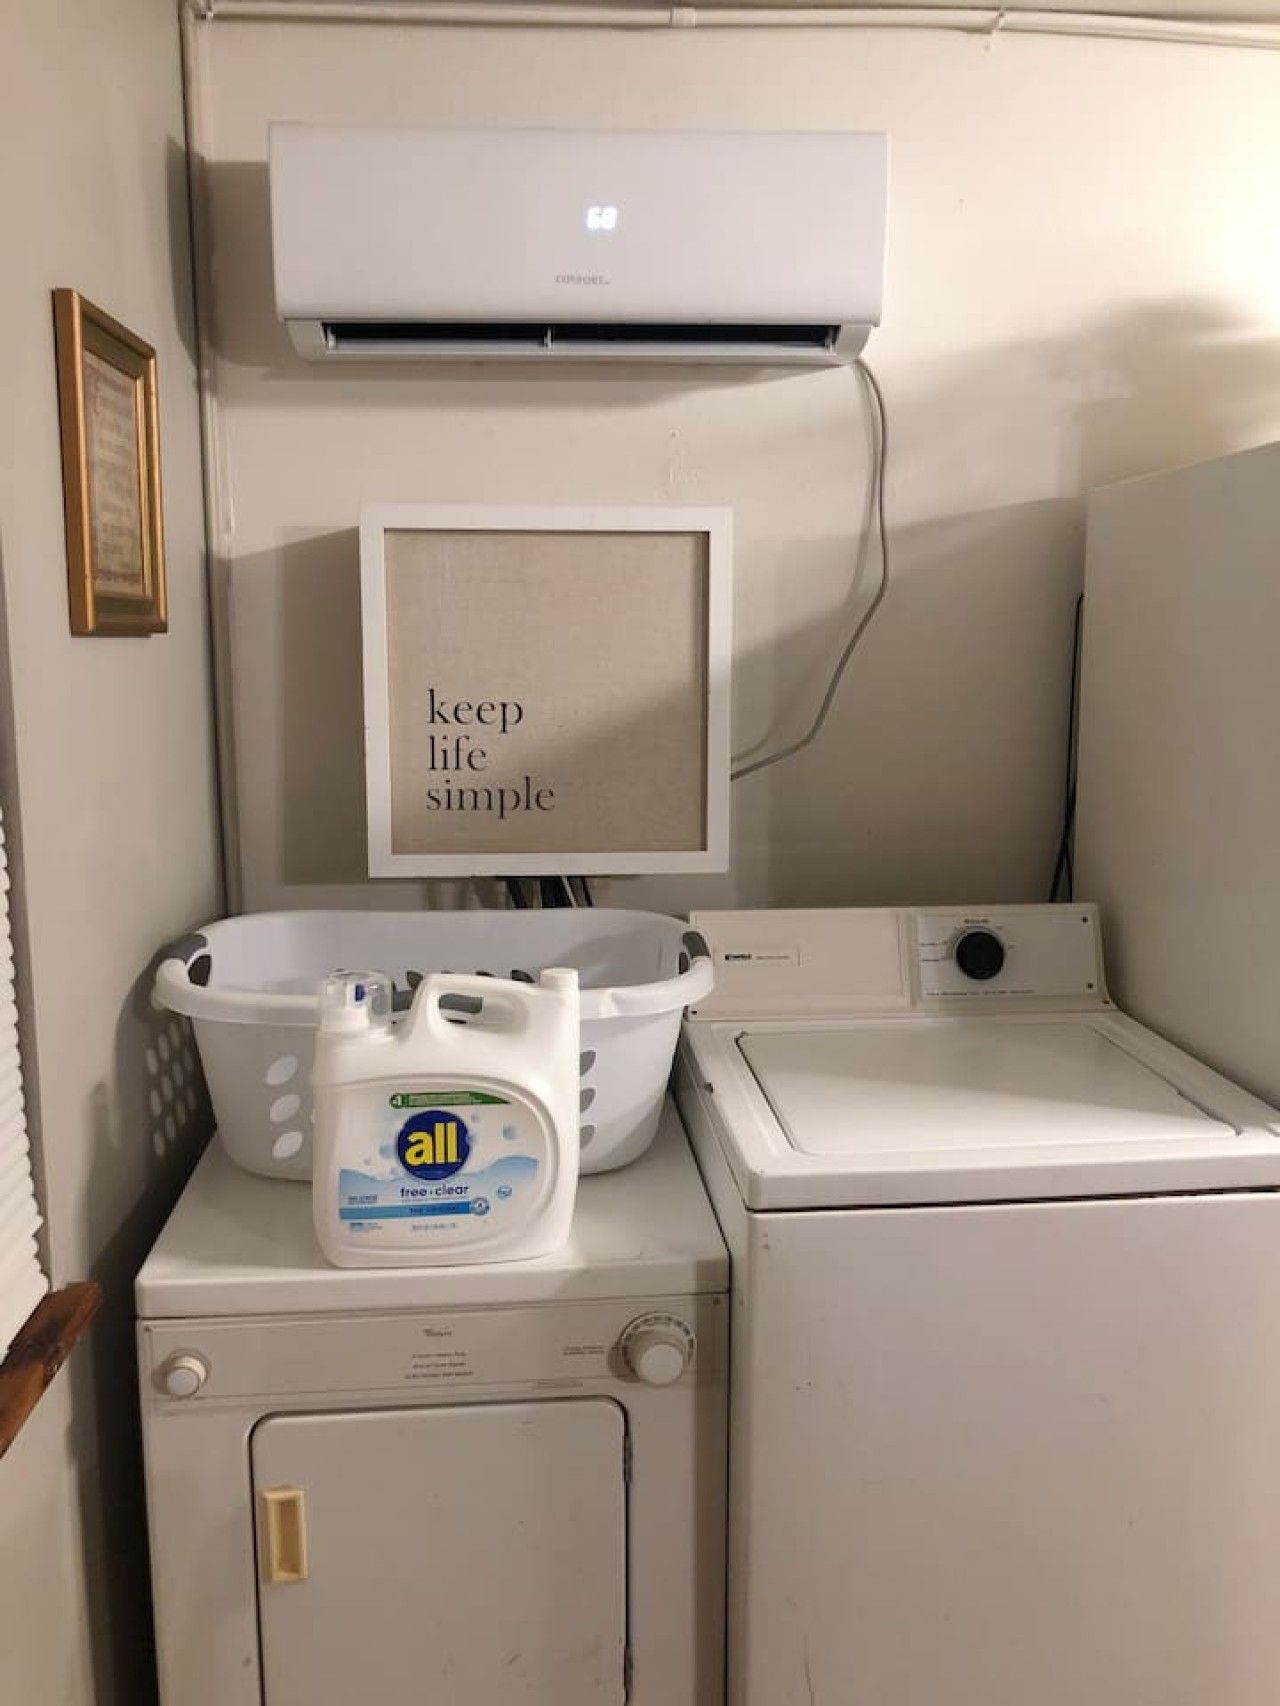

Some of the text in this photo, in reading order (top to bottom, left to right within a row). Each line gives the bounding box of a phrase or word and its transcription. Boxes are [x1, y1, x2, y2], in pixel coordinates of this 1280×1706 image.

[427, 688, 523, 734] keep
[427, 735, 488, 771] life
[426, 775, 556, 820] simple
[404, 1122, 459, 1167] all
[400, 1184, 469, 1198] free clear
